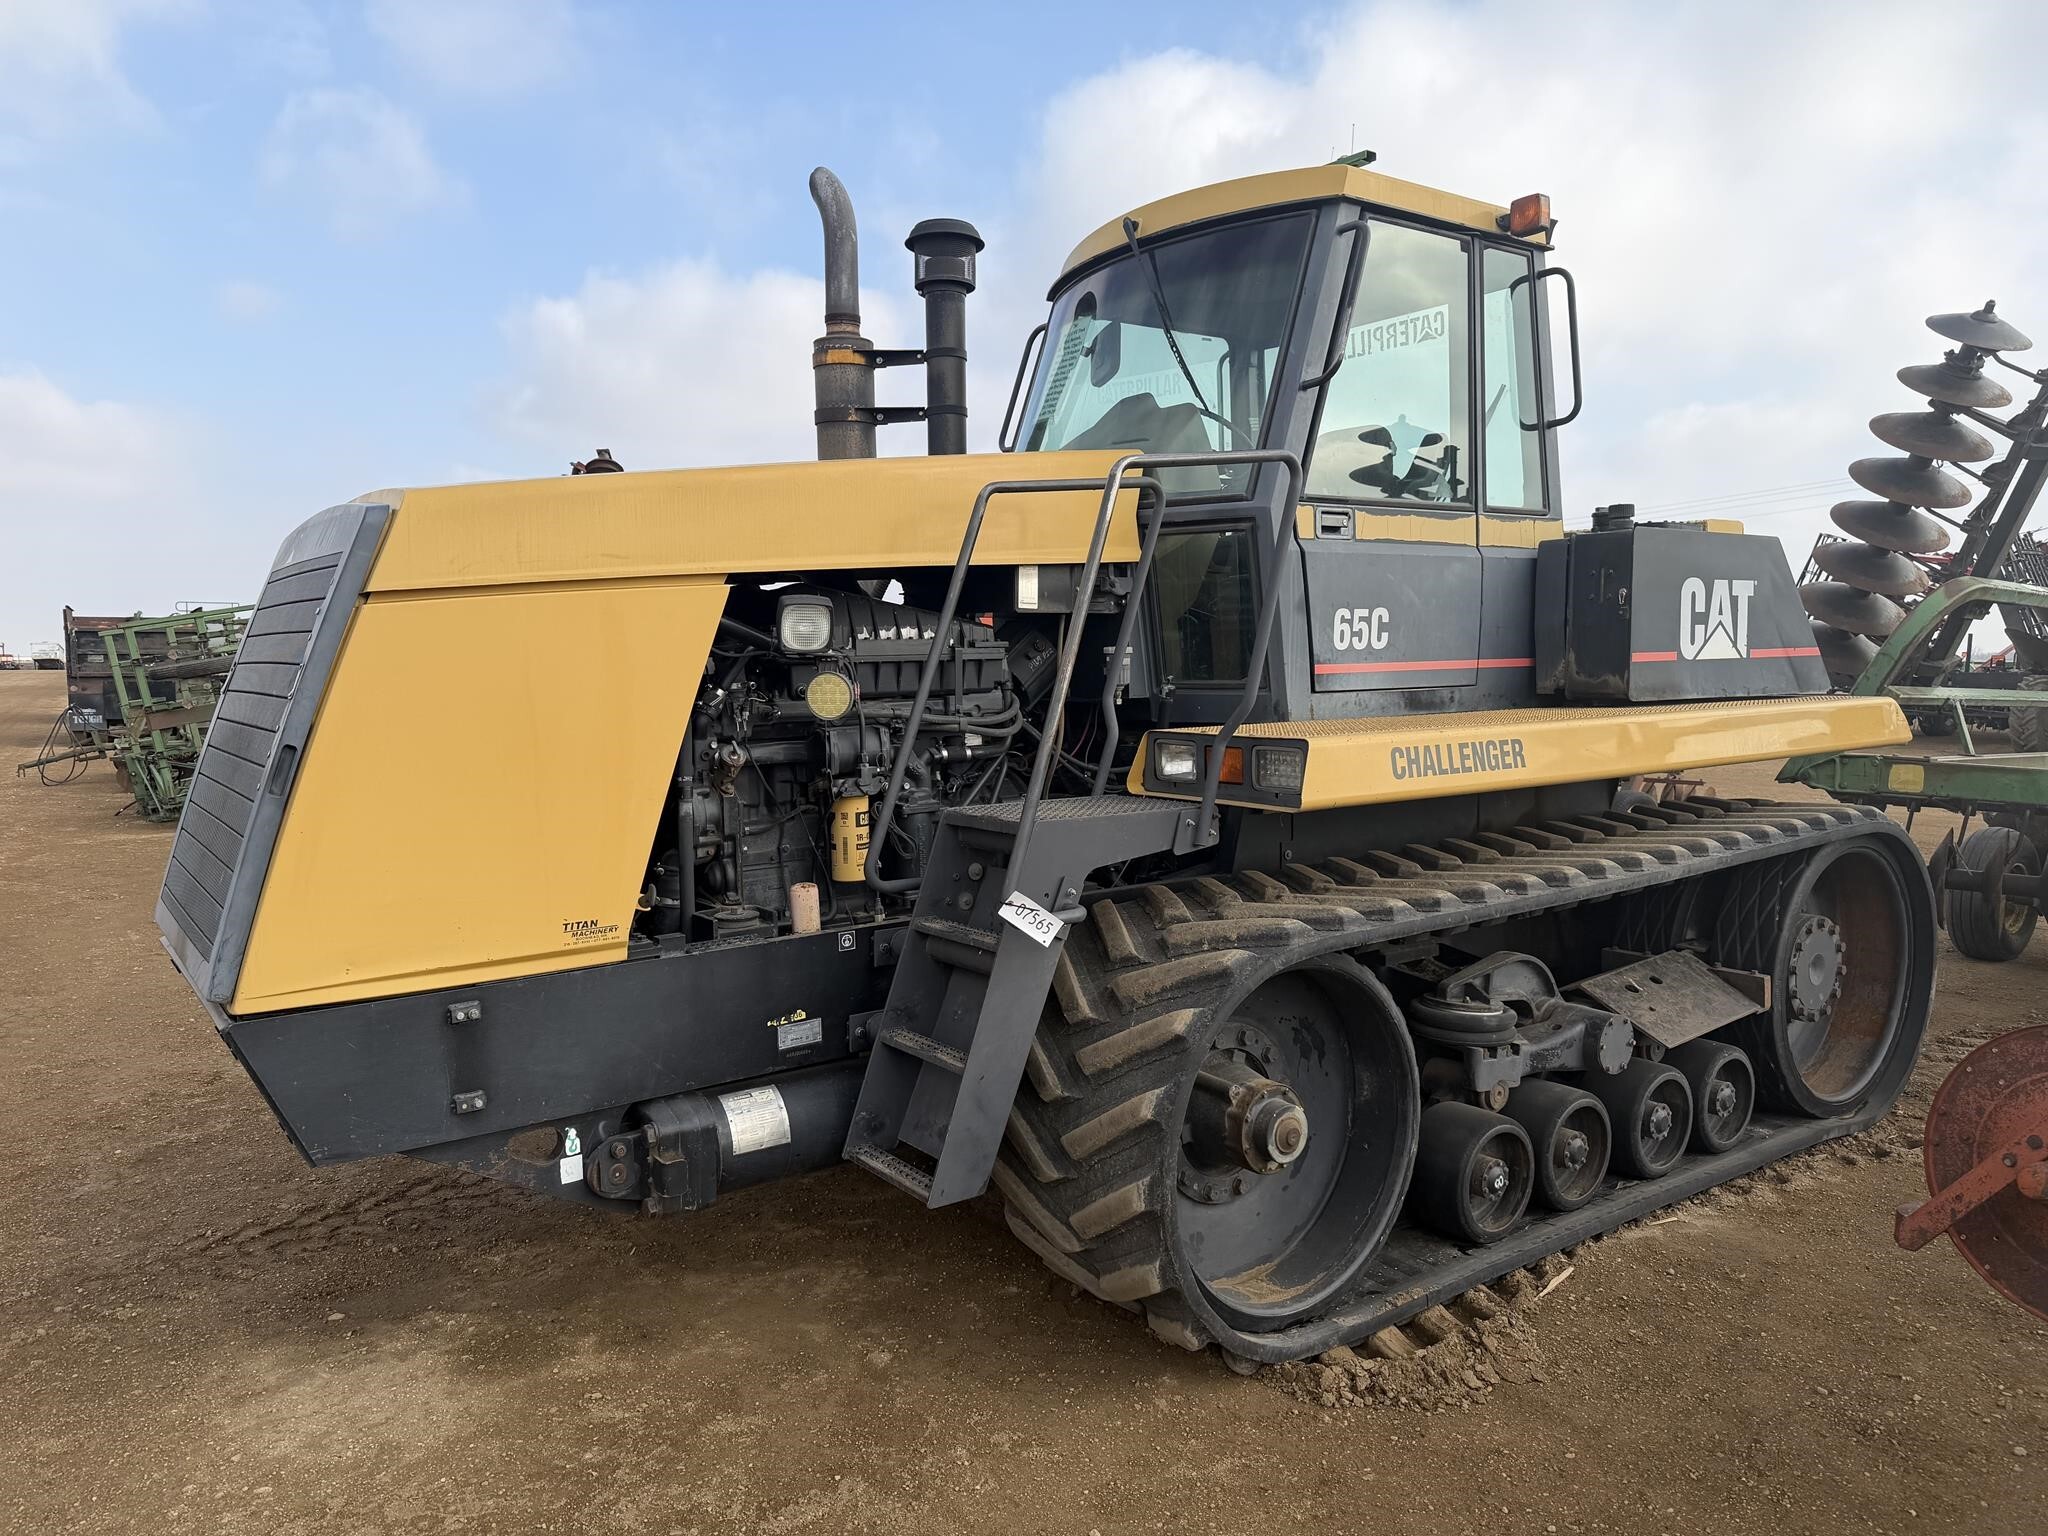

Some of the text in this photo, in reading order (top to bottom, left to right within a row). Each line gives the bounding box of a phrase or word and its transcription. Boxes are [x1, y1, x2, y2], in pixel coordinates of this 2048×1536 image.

[1333, 607, 1389, 650] 65C
[1680, 577, 1754, 660] CAT
[1390, 739, 1527, 780] CHALLENGER
[562, 919, 598, 931] TITAN
[571, 926, 619, 938] MACHINERY
[1015, 903, 1054, 935] 07565
